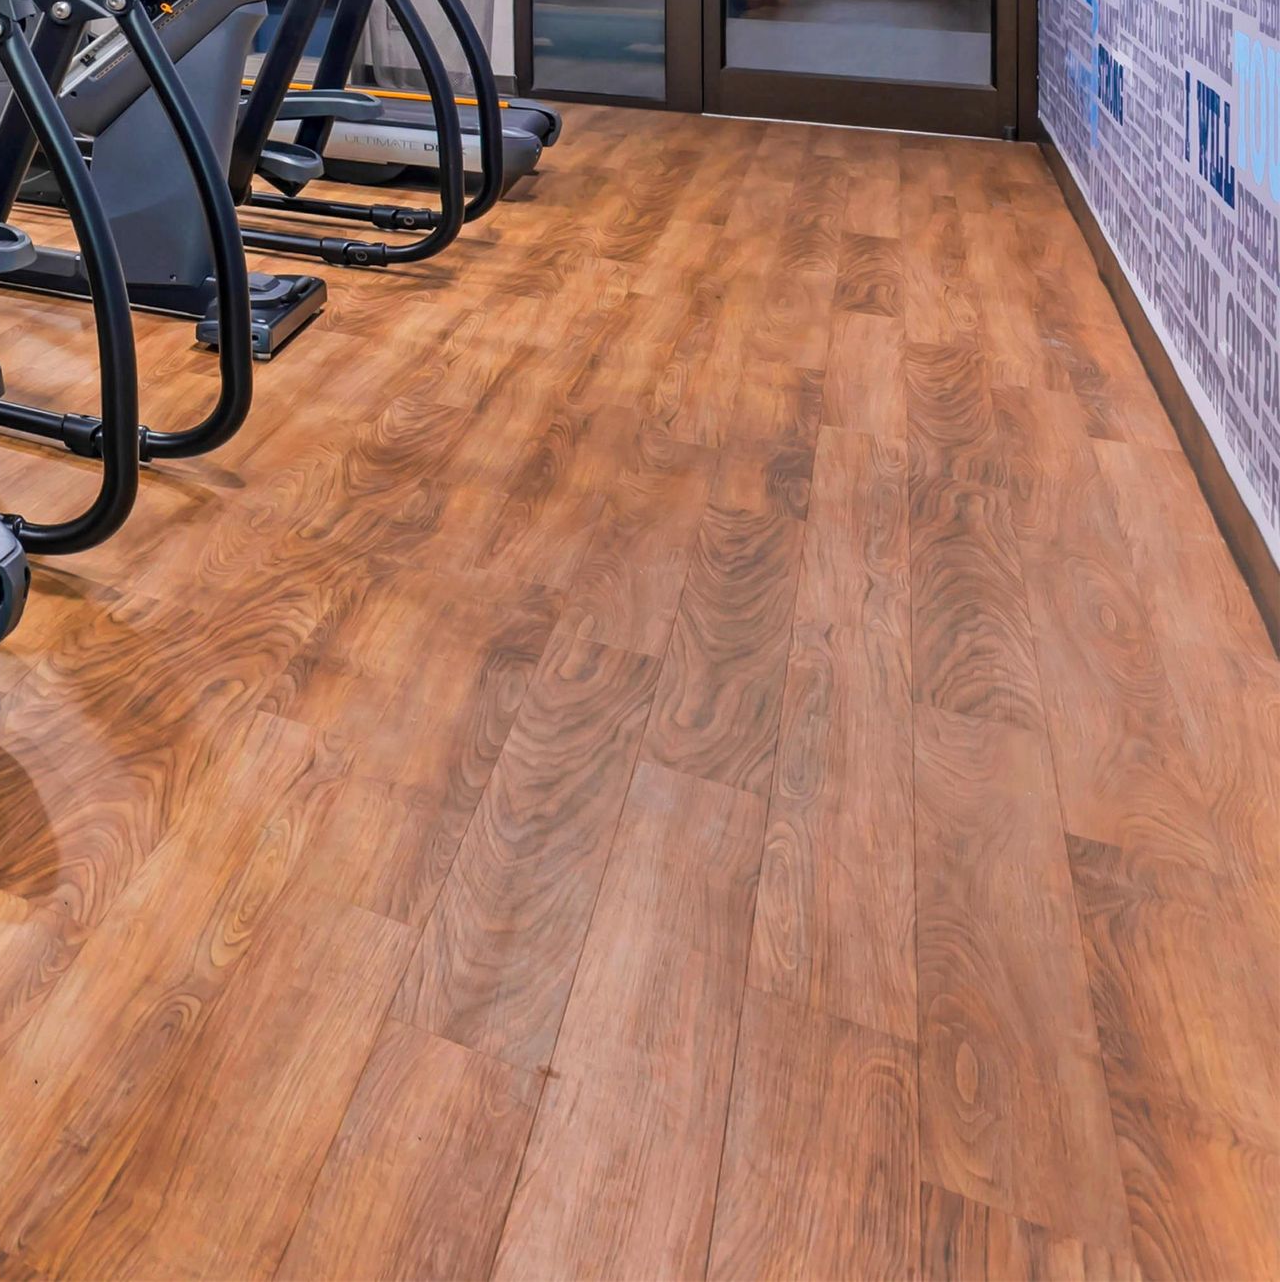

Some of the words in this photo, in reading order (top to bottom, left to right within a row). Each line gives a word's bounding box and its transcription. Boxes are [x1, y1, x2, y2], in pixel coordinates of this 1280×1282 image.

[344, 133, 420, 151] ULTIMATE
[1185, 70, 1190, 163] I
[1197, 79, 1235, 211] WILL
